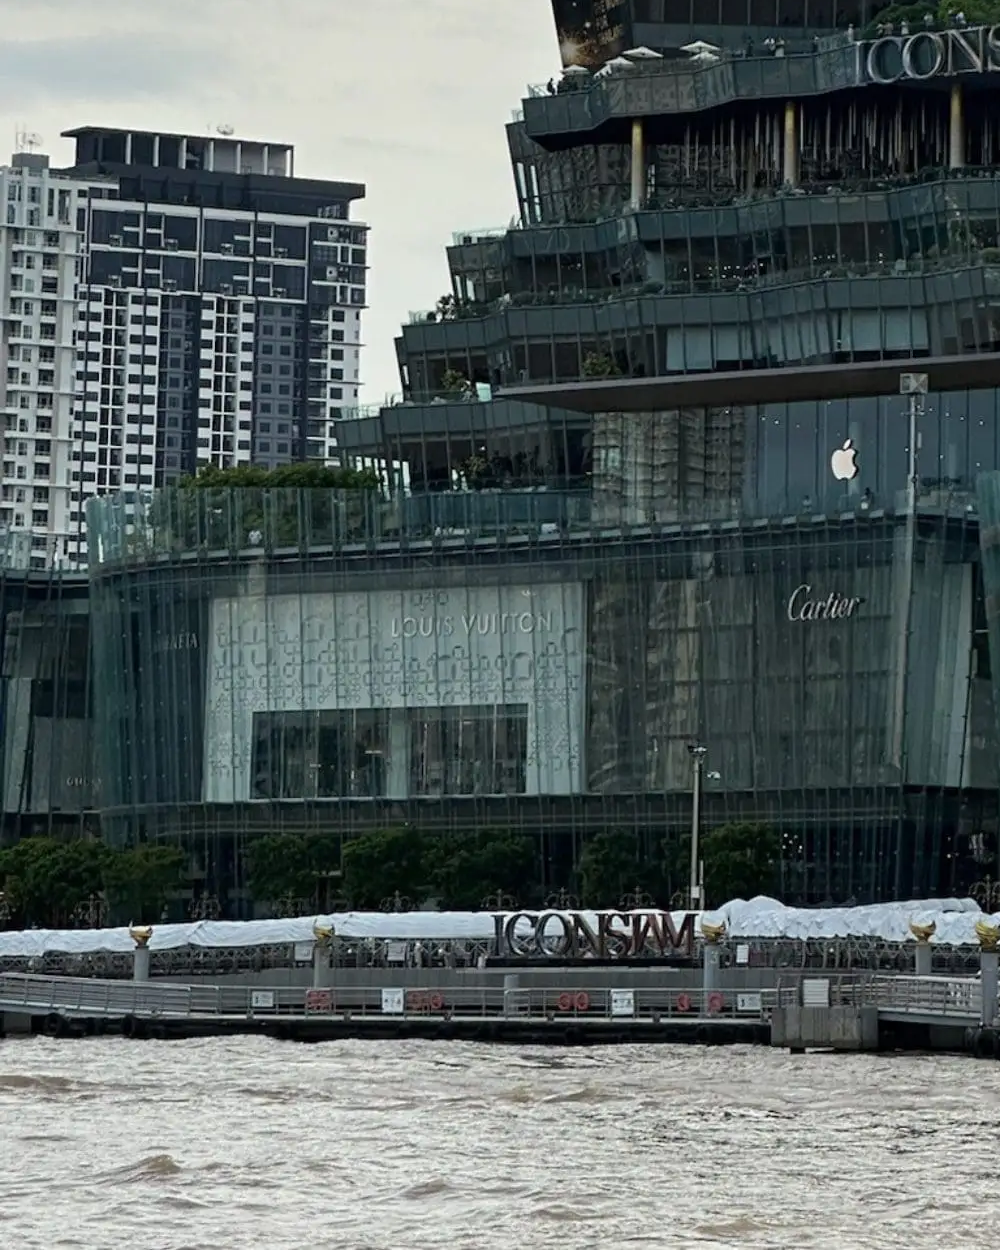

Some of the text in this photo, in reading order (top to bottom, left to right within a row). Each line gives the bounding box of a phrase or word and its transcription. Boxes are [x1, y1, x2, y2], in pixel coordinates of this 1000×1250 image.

[787, 584, 860, 622] Cartier
[391, 611, 554, 638] LOUIS VUITTON
[491, 912, 700, 958] ICONSIAM
